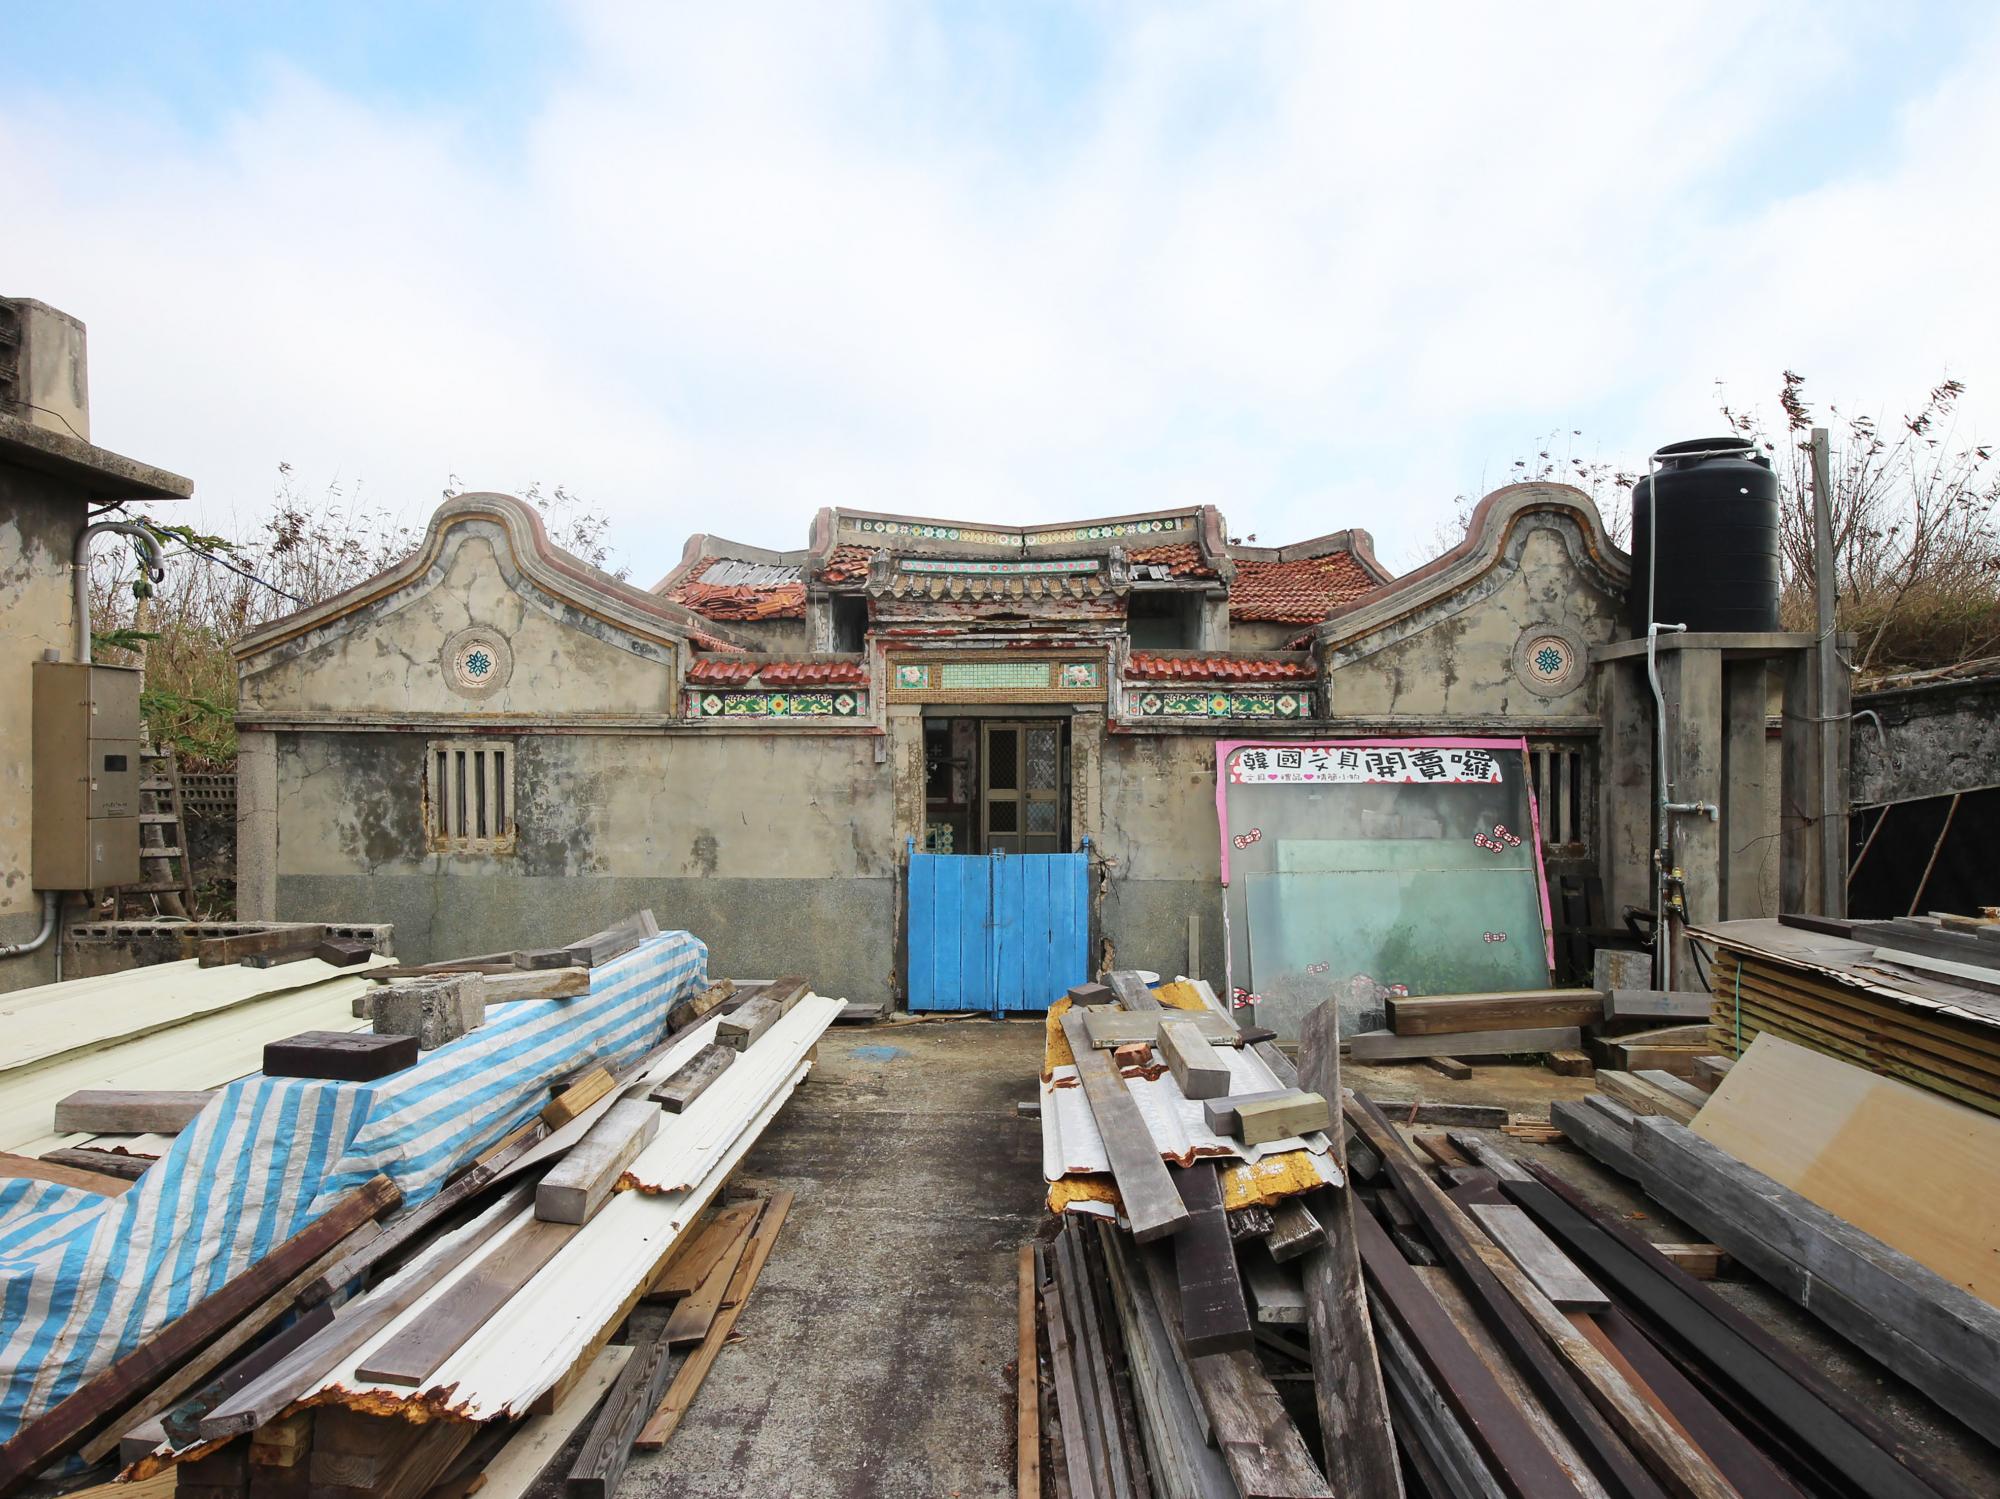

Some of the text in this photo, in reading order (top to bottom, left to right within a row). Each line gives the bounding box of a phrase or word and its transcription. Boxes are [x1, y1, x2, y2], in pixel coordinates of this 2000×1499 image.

[1243, 749, 1493, 780] 韓國文具開賣囉
